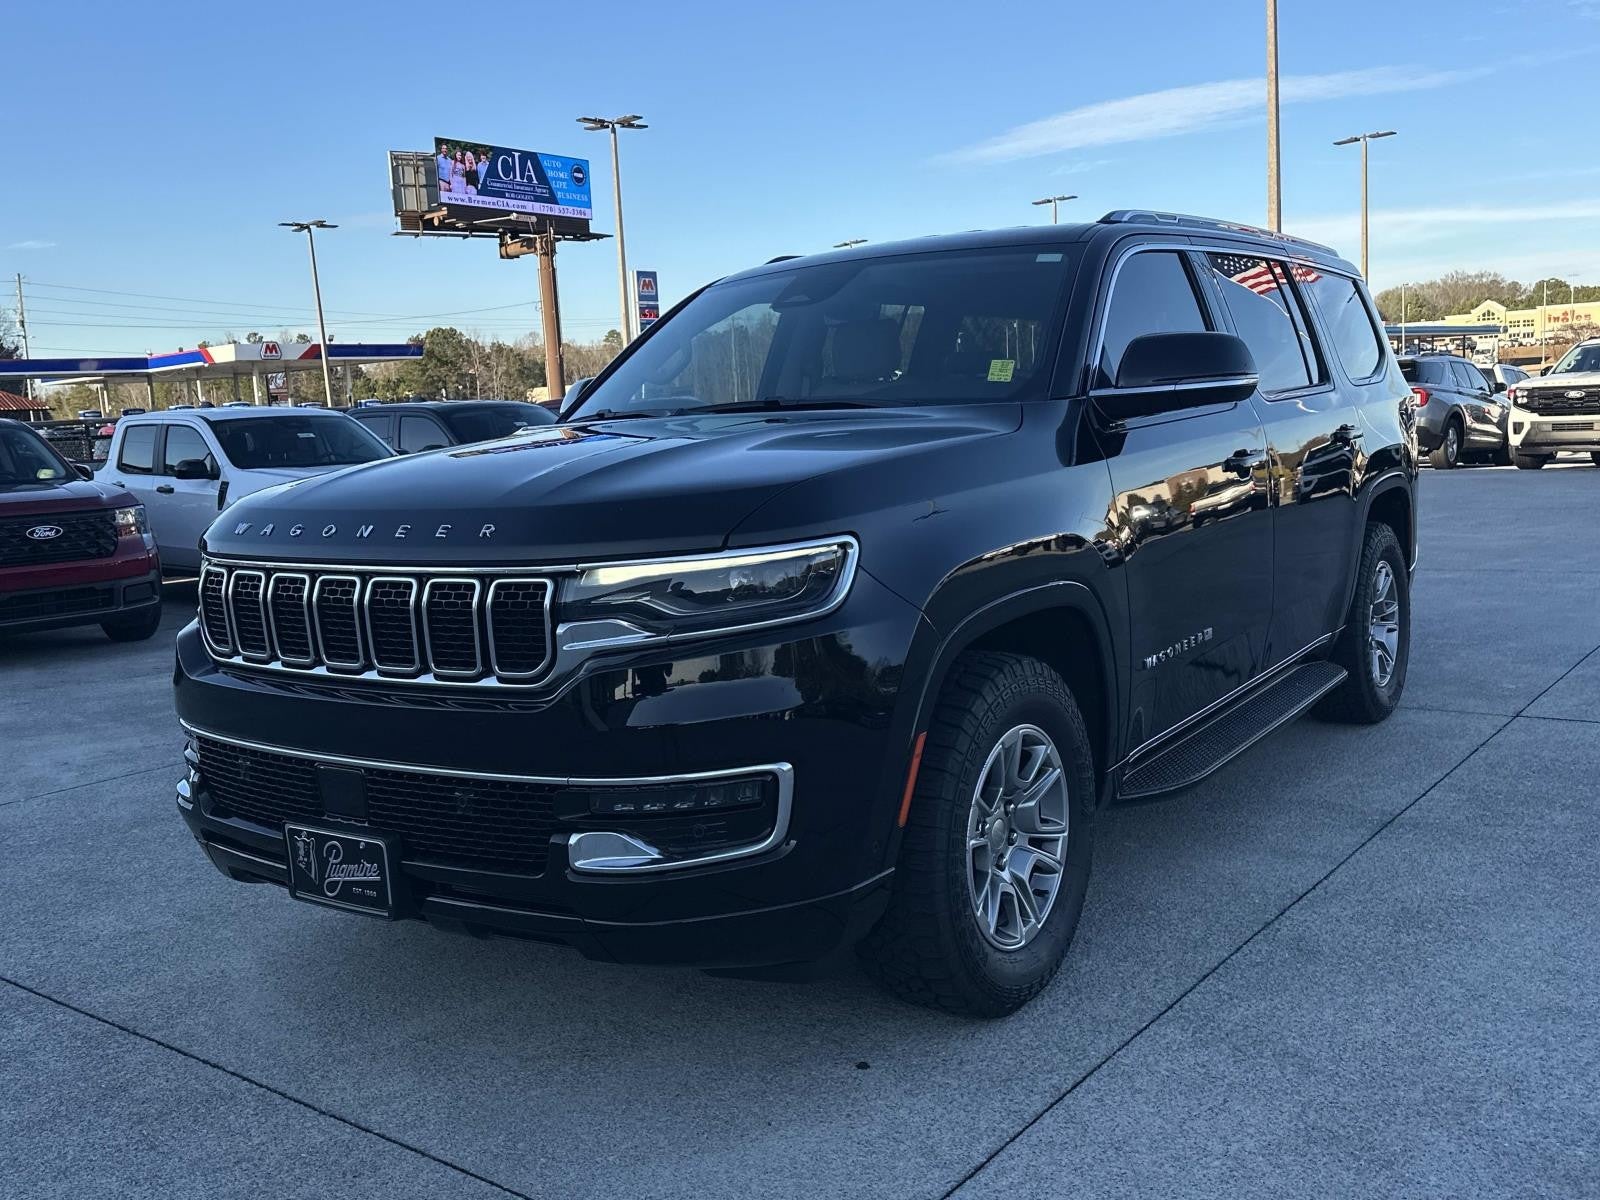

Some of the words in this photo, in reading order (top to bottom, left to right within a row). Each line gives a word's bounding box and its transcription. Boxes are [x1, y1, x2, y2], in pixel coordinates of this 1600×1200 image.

[498, 152, 538, 184] CIA
[543, 160, 562, 168] AUTO
[548, 170, 570, 179] HOME
[552, 180, 568, 189] LIFE
[447, 195, 527, 210] www.BremenCIA.com
[557, 191, 589, 202] BUSINESS
[31, 526, 59, 538] Ford
[234, 523, 496, 539] WAGONEER
[1143, 631, 1204, 670] WAGONEER
[323, 840, 381, 897] Pugmire
